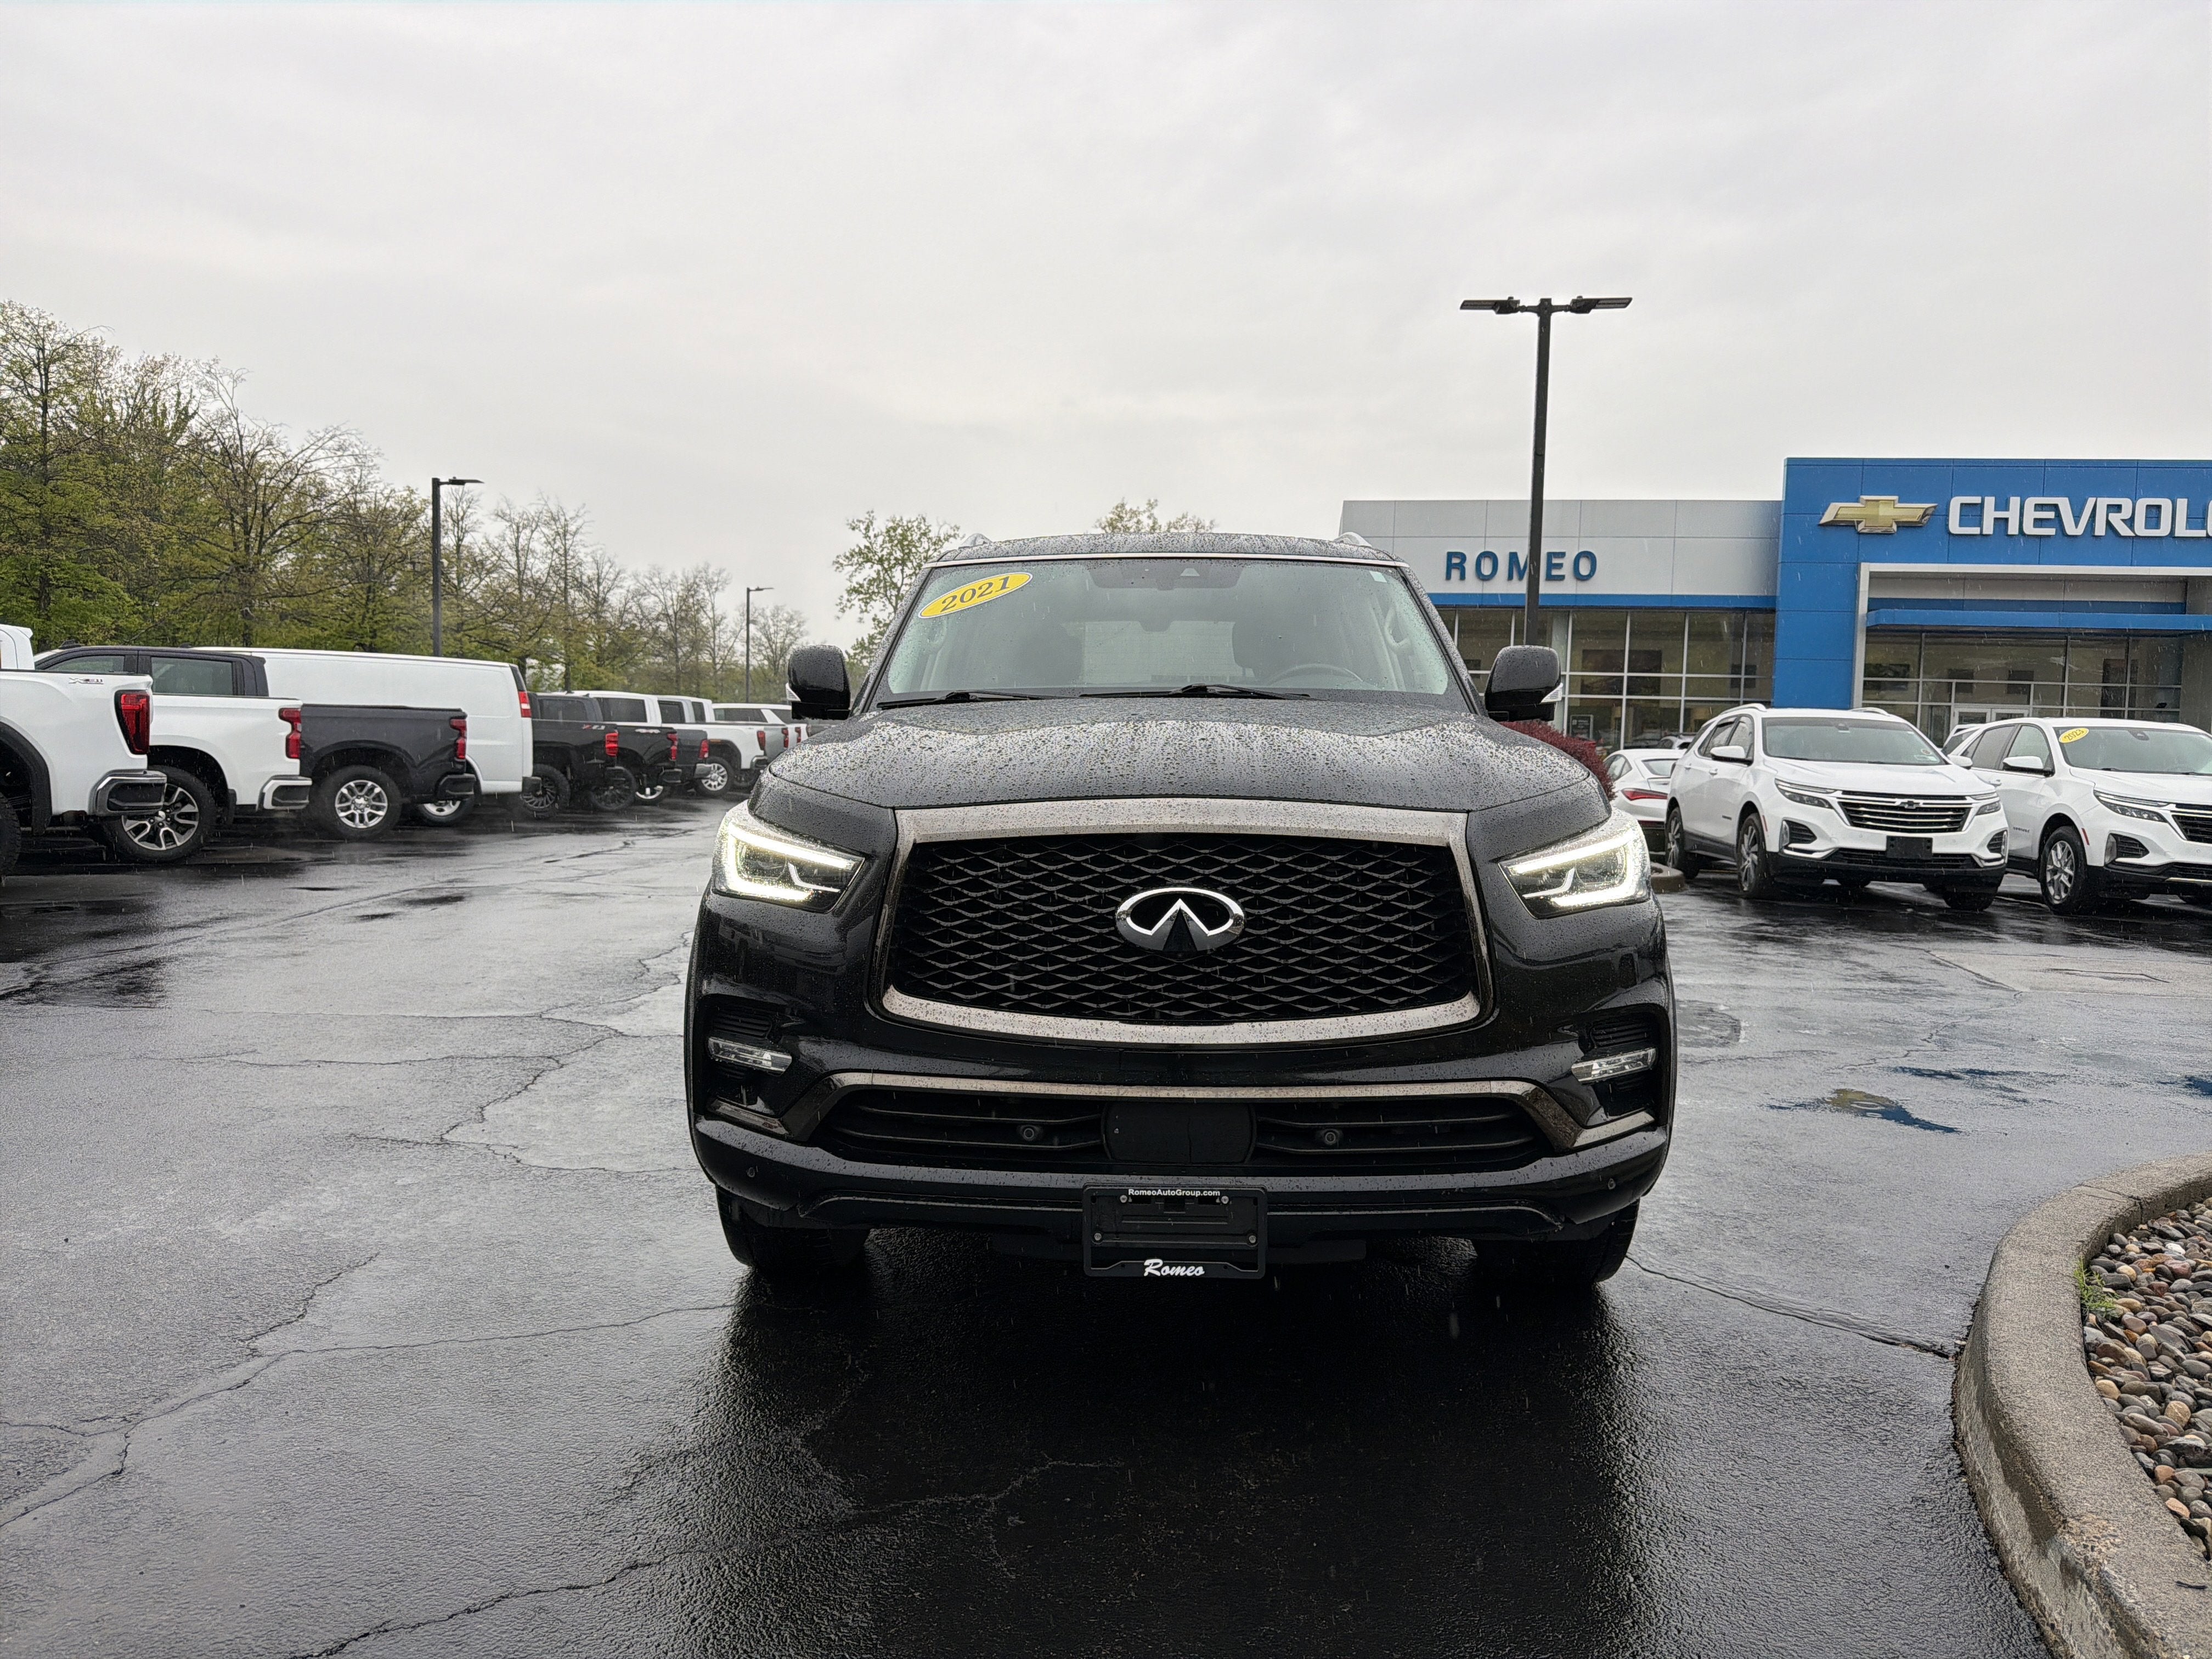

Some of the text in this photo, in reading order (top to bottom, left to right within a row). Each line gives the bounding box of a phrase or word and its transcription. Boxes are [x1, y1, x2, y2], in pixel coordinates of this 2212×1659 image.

[1948, 496, 2212, 537] CHEVROL
[1445, 550, 1597, 581] ROMEO
[940, 576, 1010, 613] 2021
[2063, 729, 2085, 741] 2023
[1128, 1189, 1220, 1197] RomeoAutoGroup.com
[1143, 1259, 1205, 1277] Romeo
